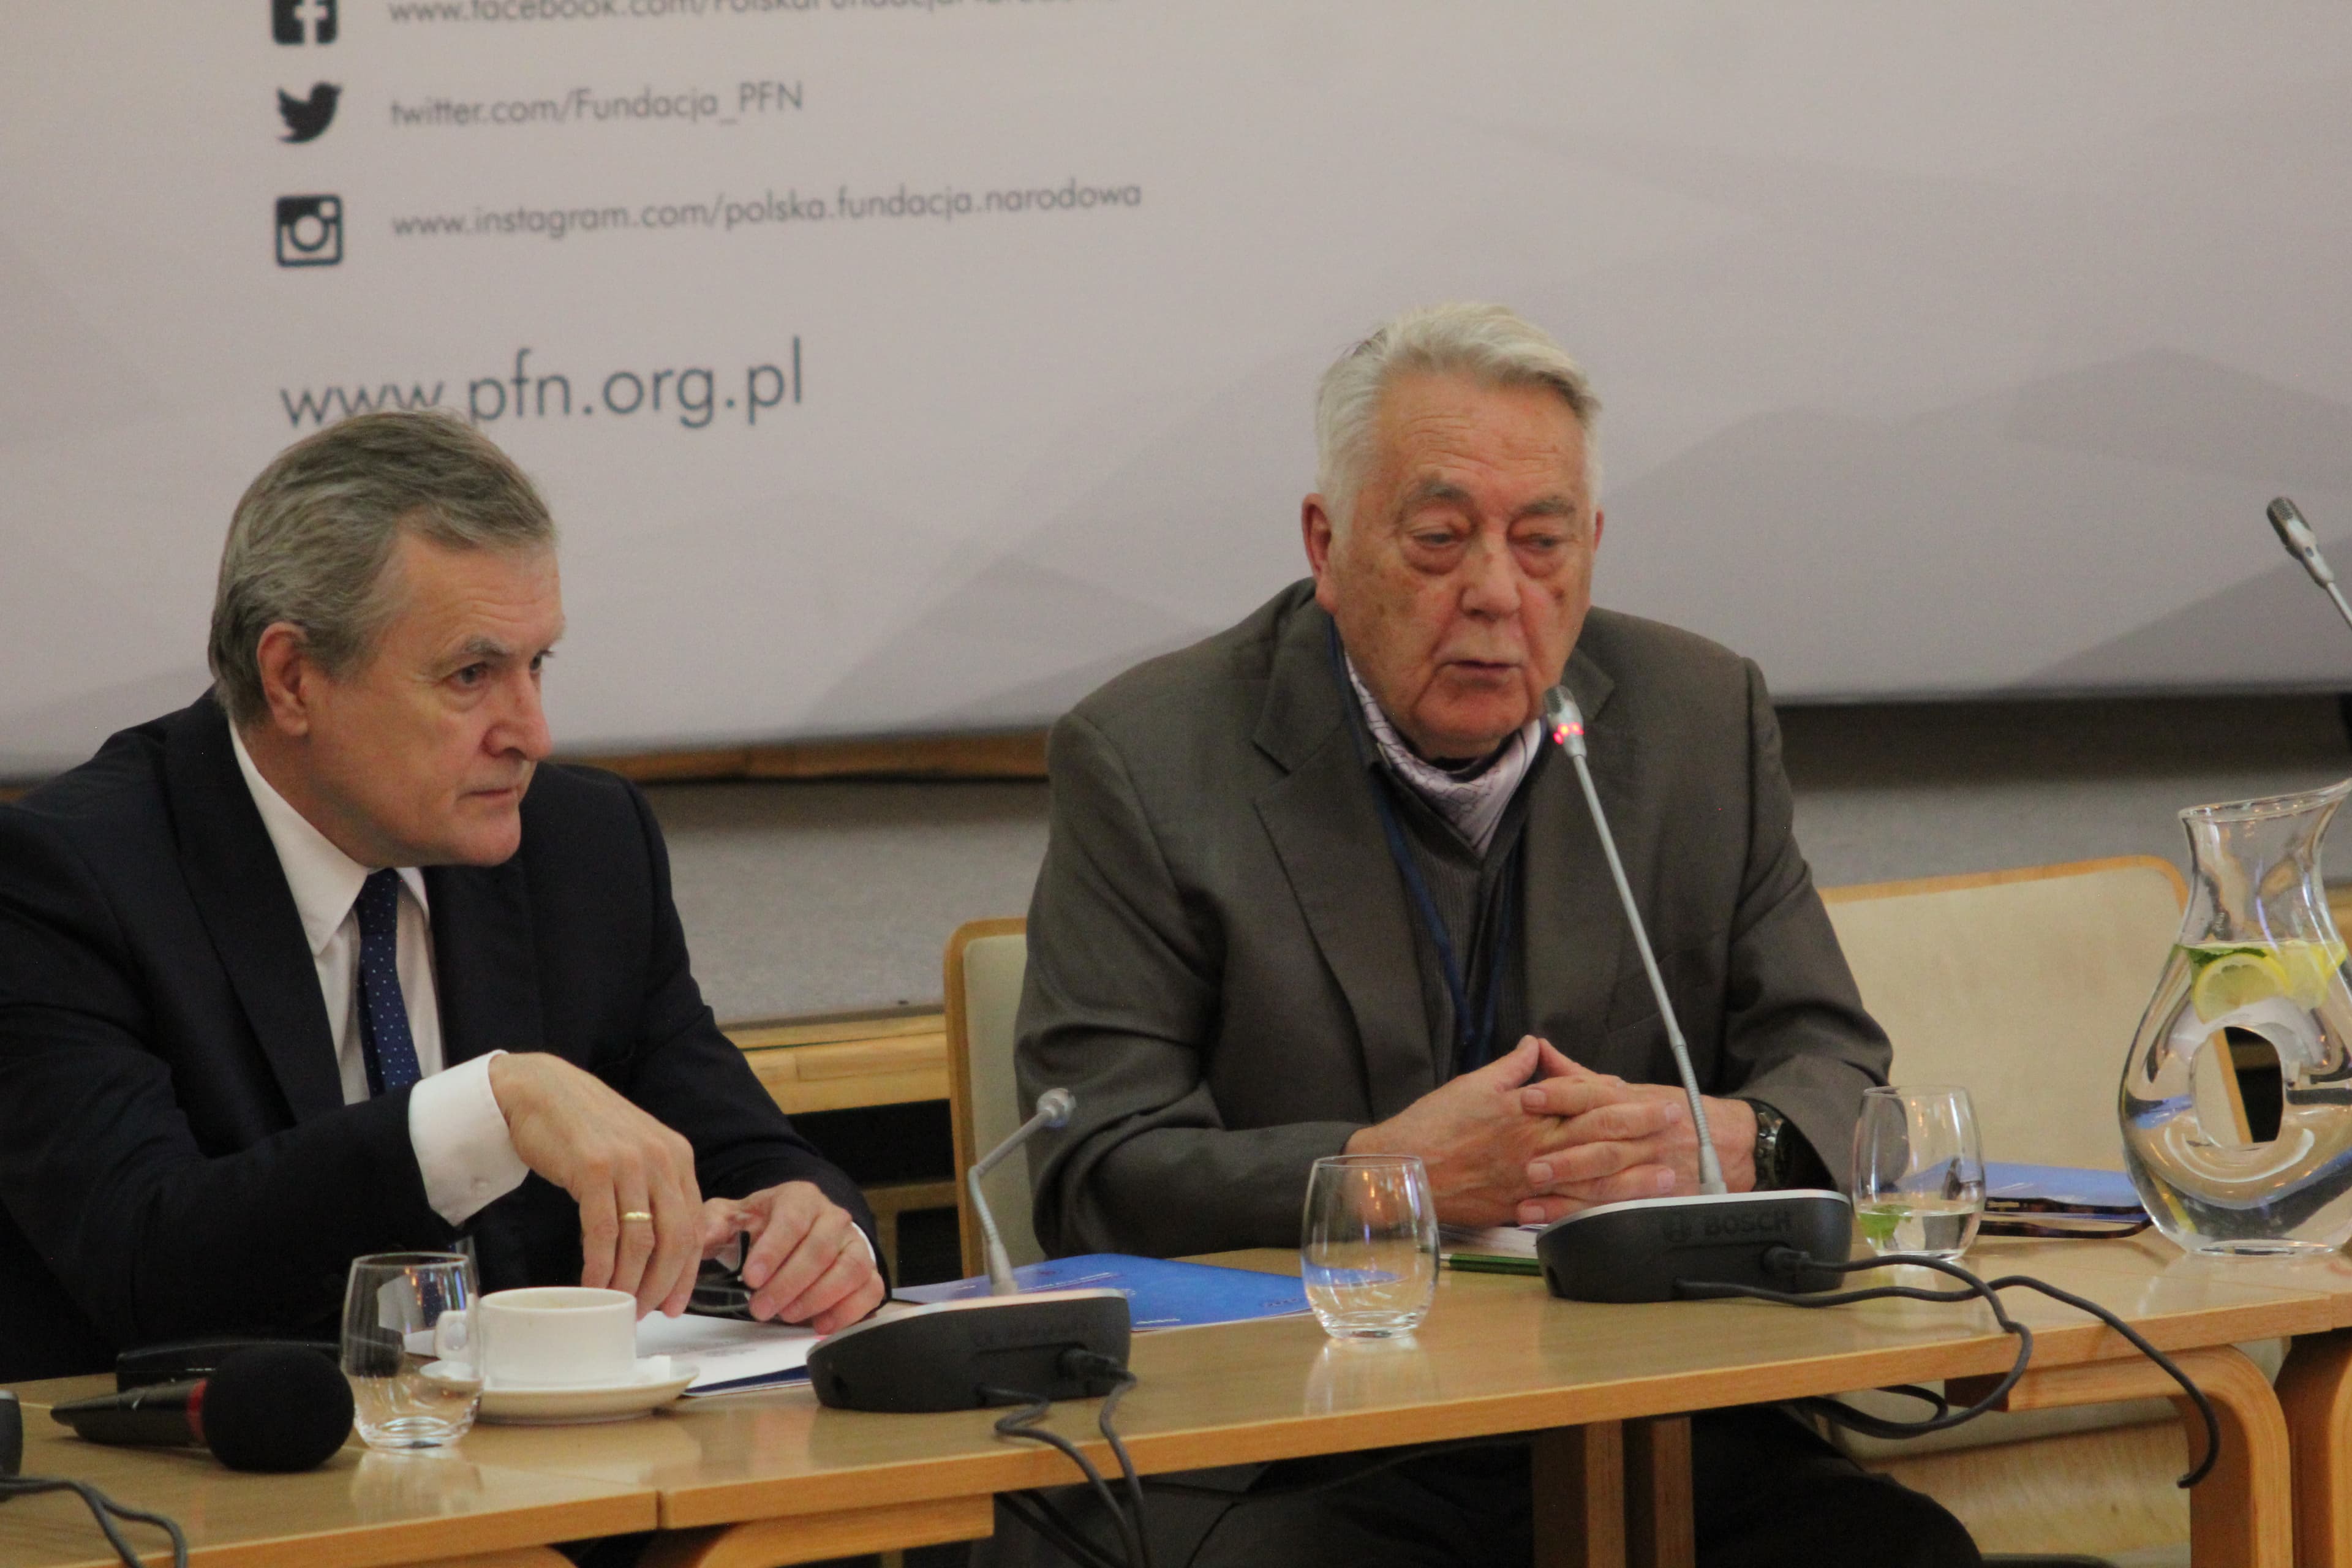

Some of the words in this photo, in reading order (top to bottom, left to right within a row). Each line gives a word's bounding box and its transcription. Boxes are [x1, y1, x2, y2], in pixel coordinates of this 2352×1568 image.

[390, 80, 804, 127] twitter.com/Fundacja_PFN
[391, 177, 1142, 241] www.instagram.com/polska.fundacja.narodowa
[279, 334, 803, 429] wwwpfn.org.pl
[1703, 1210, 1792, 1237] BOSCH
